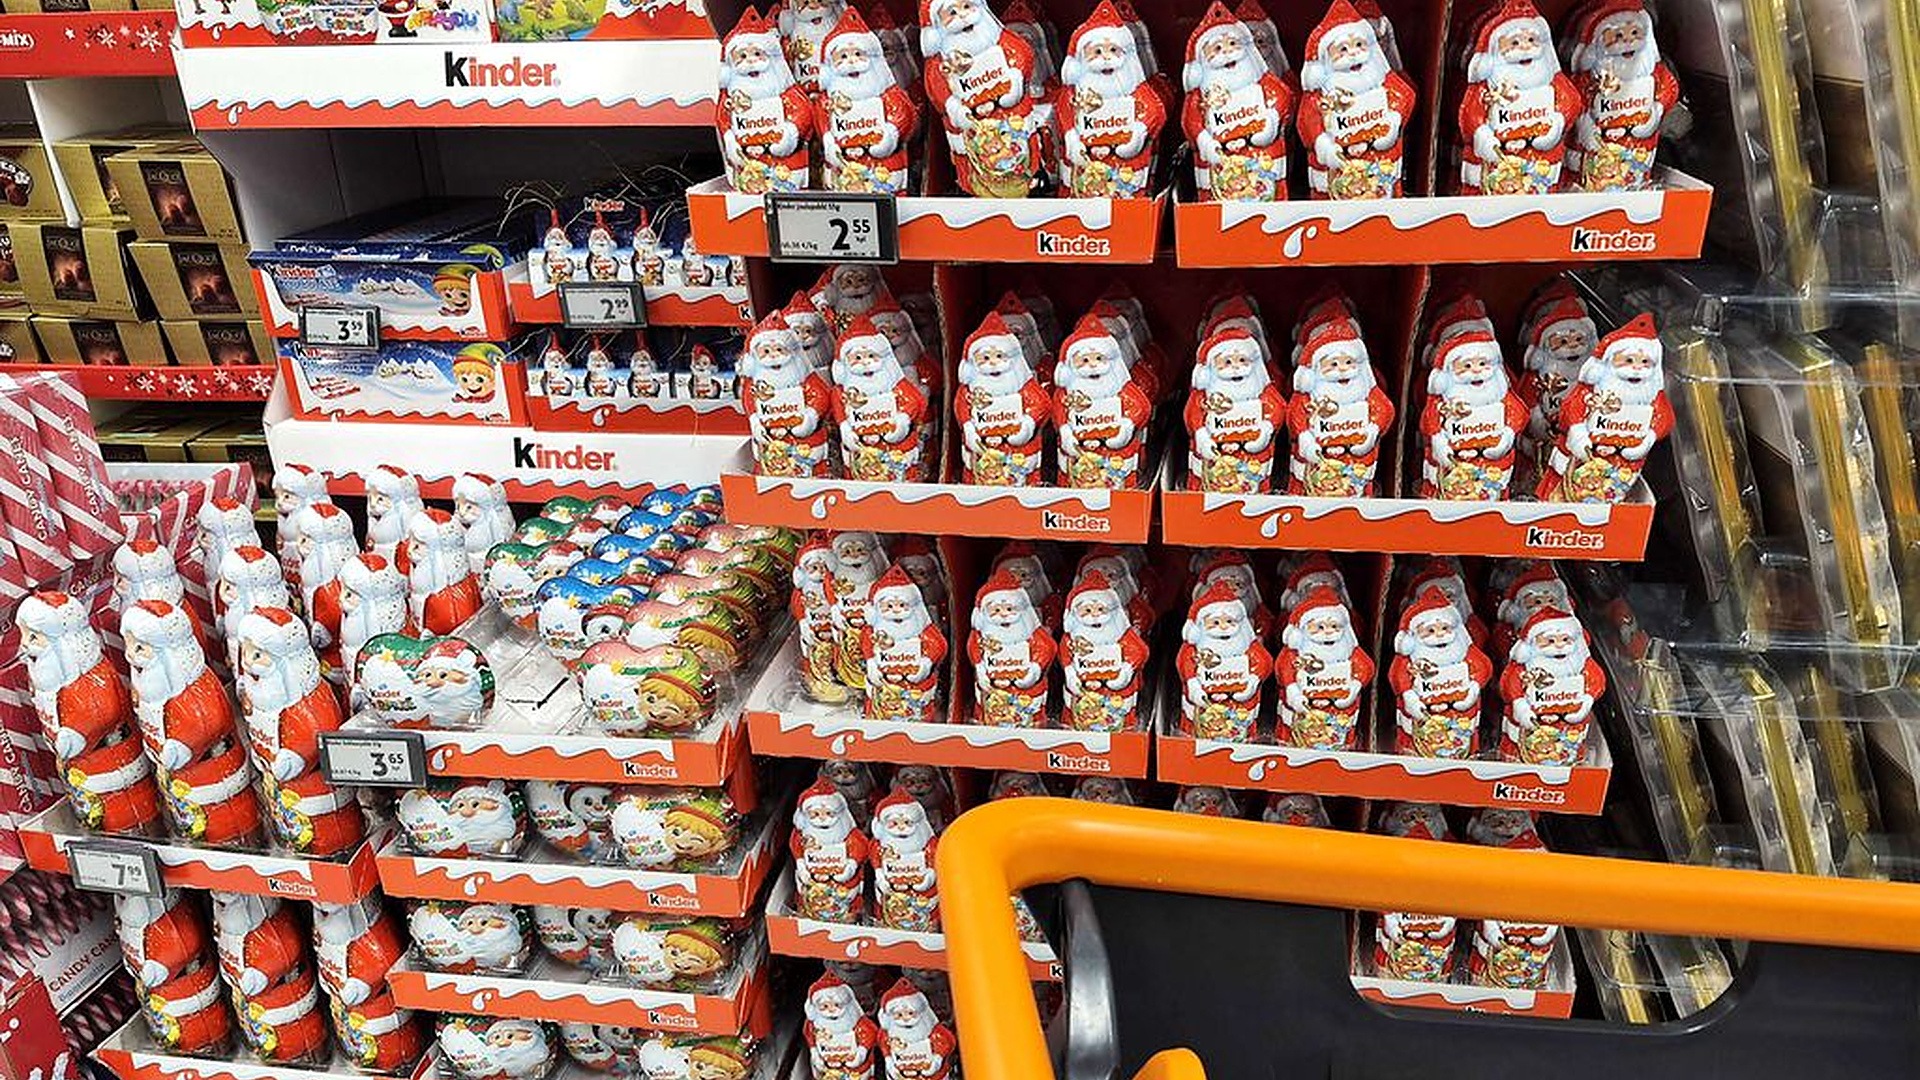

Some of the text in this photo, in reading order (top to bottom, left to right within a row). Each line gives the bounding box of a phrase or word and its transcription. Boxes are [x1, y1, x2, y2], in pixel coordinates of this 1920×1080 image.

[445, 51, 558, 88] Kinder
[800, 63, 820, 76] Kin
[959, 66, 1005, 93] Kinder
[1600, 97, 1649, 113] Kinder
[1083, 115, 1129, 130] Kinder
[1214, 104, 1261, 126] Kinder
[1336, 107, 1386, 130] Kinder
[1499, 106, 1549, 123] Kinder
[736, 117, 778, 130] Kinder
[835, 117, 879, 131] Kinder
[829, 218, 871, 250] 2 55
[1573, 228, 1655, 252] Kinder
[1038, 232, 1109, 254] Kinder
[600, 298, 616, 319] 2
[614, 298, 629, 309] 99
[337, 319, 350, 341] 3
[761, 403, 799, 415] Kinder
[853, 410, 892, 422] Kinder
[977, 410, 1016, 423] Kinder
[1075, 414, 1116, 426] Kinder
[1214, 417, 1257, 429] Kinder
[1319, 419, 1363, 433] Kinder
[1596, 416, 1643, 432] Kinder
[1452, 422, 1498, 436] Kinder
[513, 437, 618, 471] Kinder
[1044, 512, 1109, 530] Kinder
[1528, 528, 1603, 548] Kinder
[880, 652, 917, 662] Kinder
[987, 657, 1024, 667] Kinder
[1078, 658, 1116, 669] Kinder
[1204, 671, 1244, 681] Kinder
[1306, 675, 1348, 687] Kinder
[1422, 679, 1465, 692] Kinder
[1535, 690, 1579, 702] Kinder
[370, 753, 404, 776] 3 65
[624, 761, 678, 778] Kinder
[1049, 753, 1109, 771] Kinder
[1494, 783, 1564, 803] Kinder
[112, 864, 126, 885] 7
[127, 866, 142, 876] 99
[269, 878, 315, 896] Kinder
[649, 893, 700, 910] Kinder
[48, 954, 91, 992] CANDY
[649, 1011, 698, 1028] Kinder
